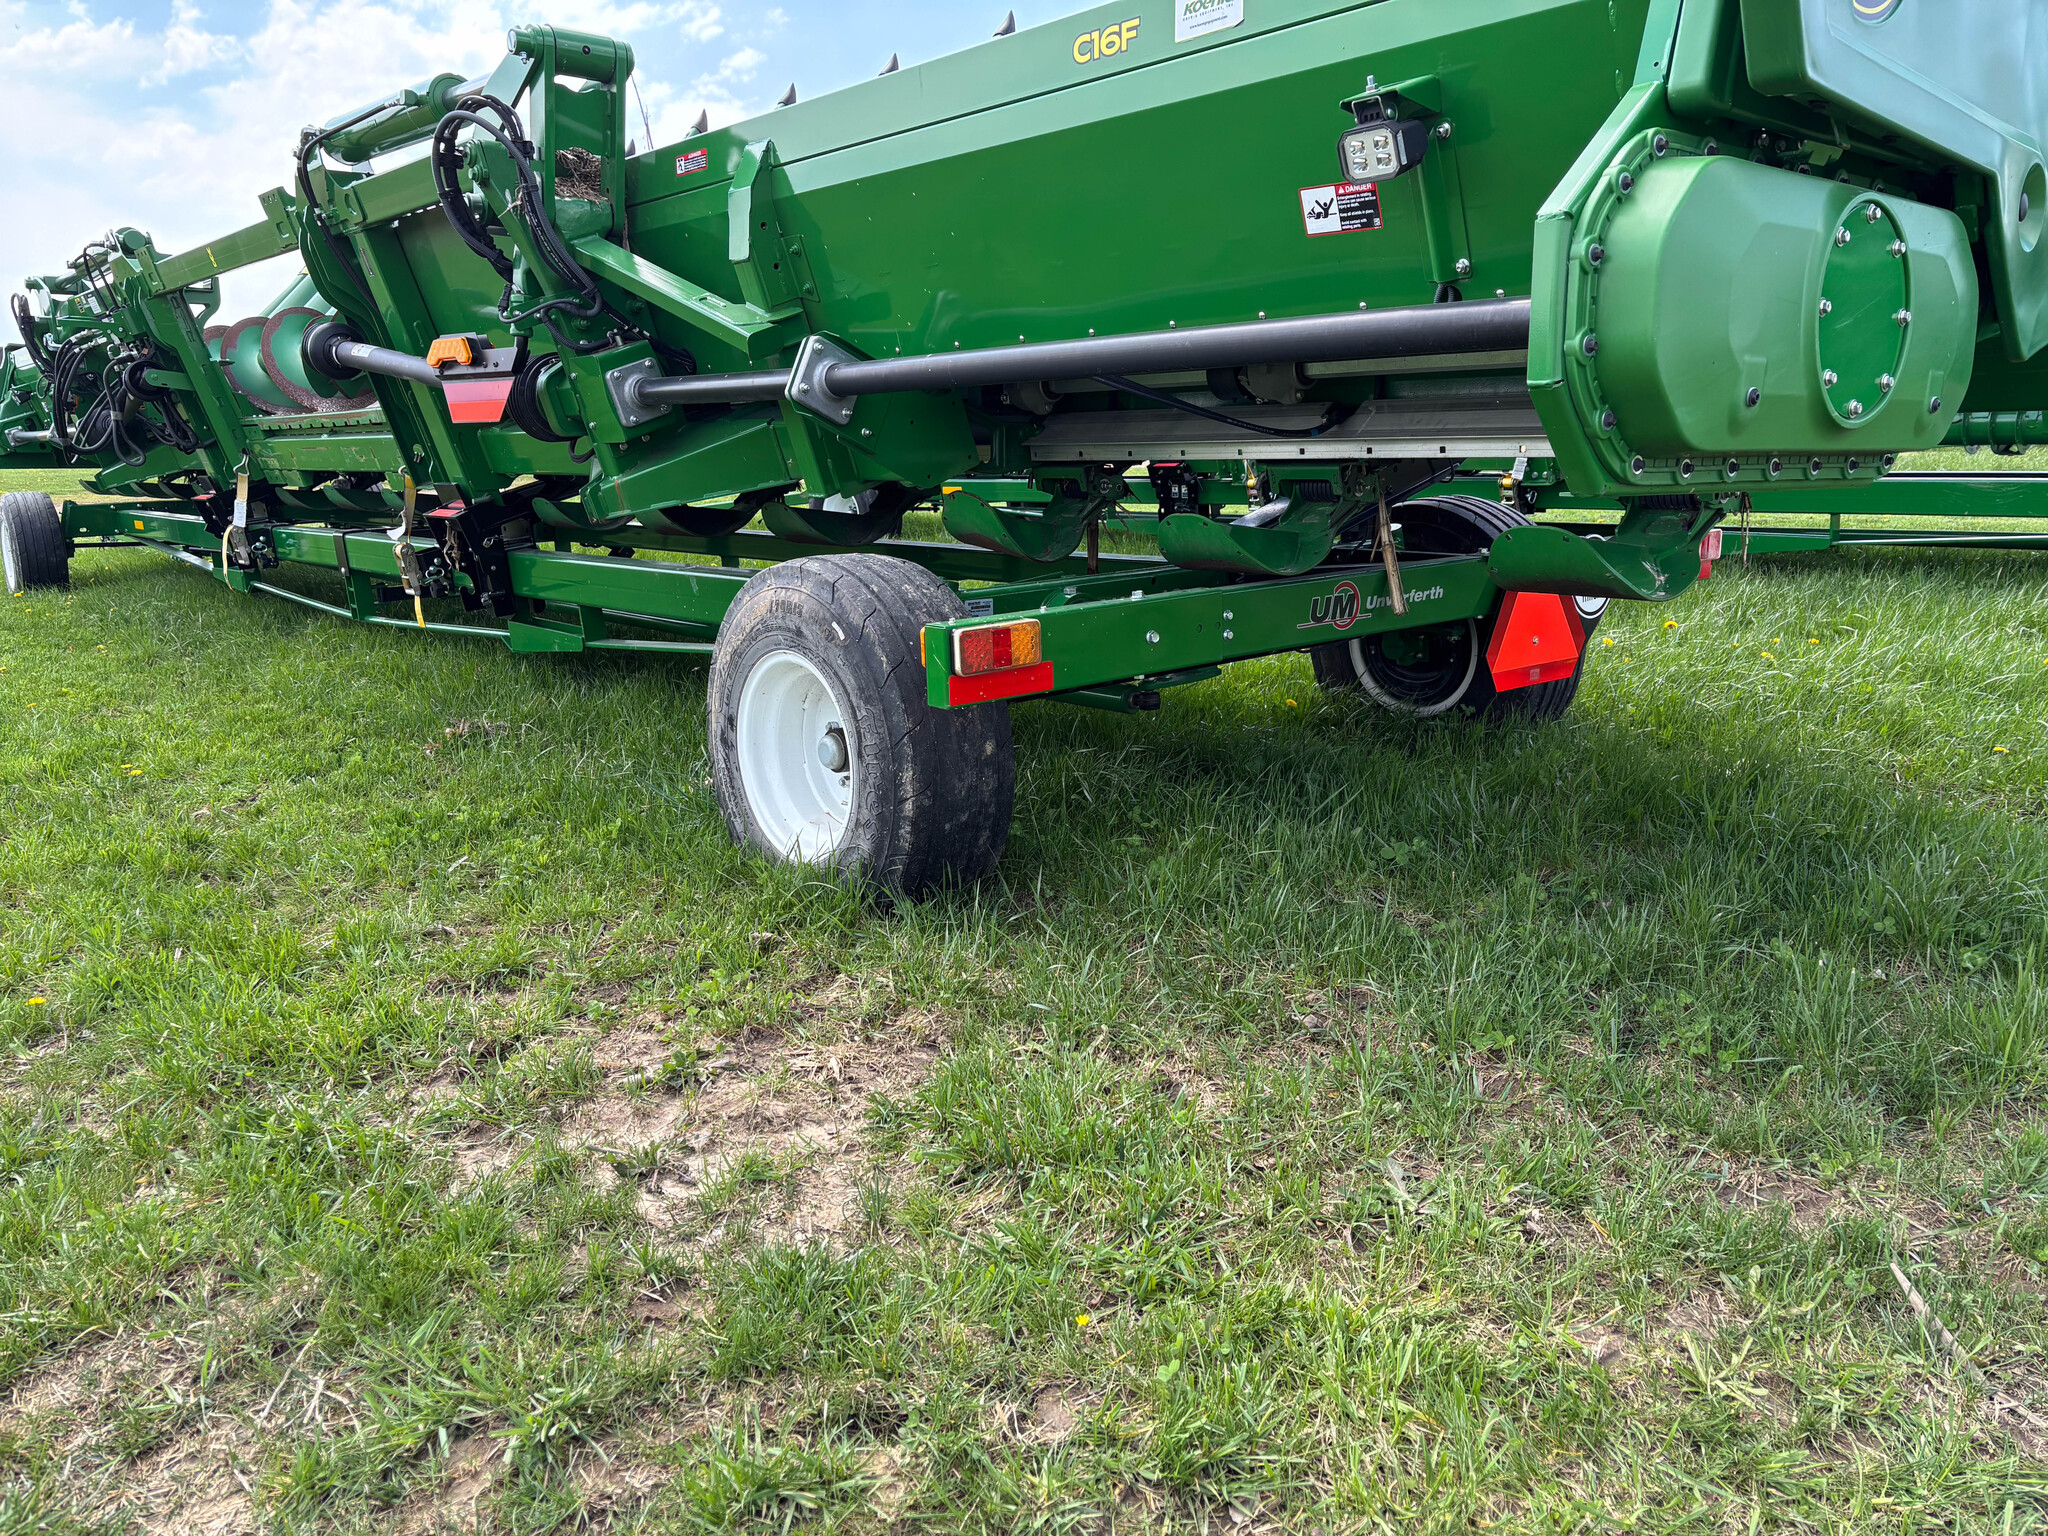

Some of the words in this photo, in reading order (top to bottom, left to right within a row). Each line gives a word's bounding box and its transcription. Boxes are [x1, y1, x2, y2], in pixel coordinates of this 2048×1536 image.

[1072, 15, 1141, 65] C16F
[1346, 183, 1372, 193] DANGER
[1310, 592, 1357, 623] UM
[1366, 586, 1444, 609] Unvrferth
